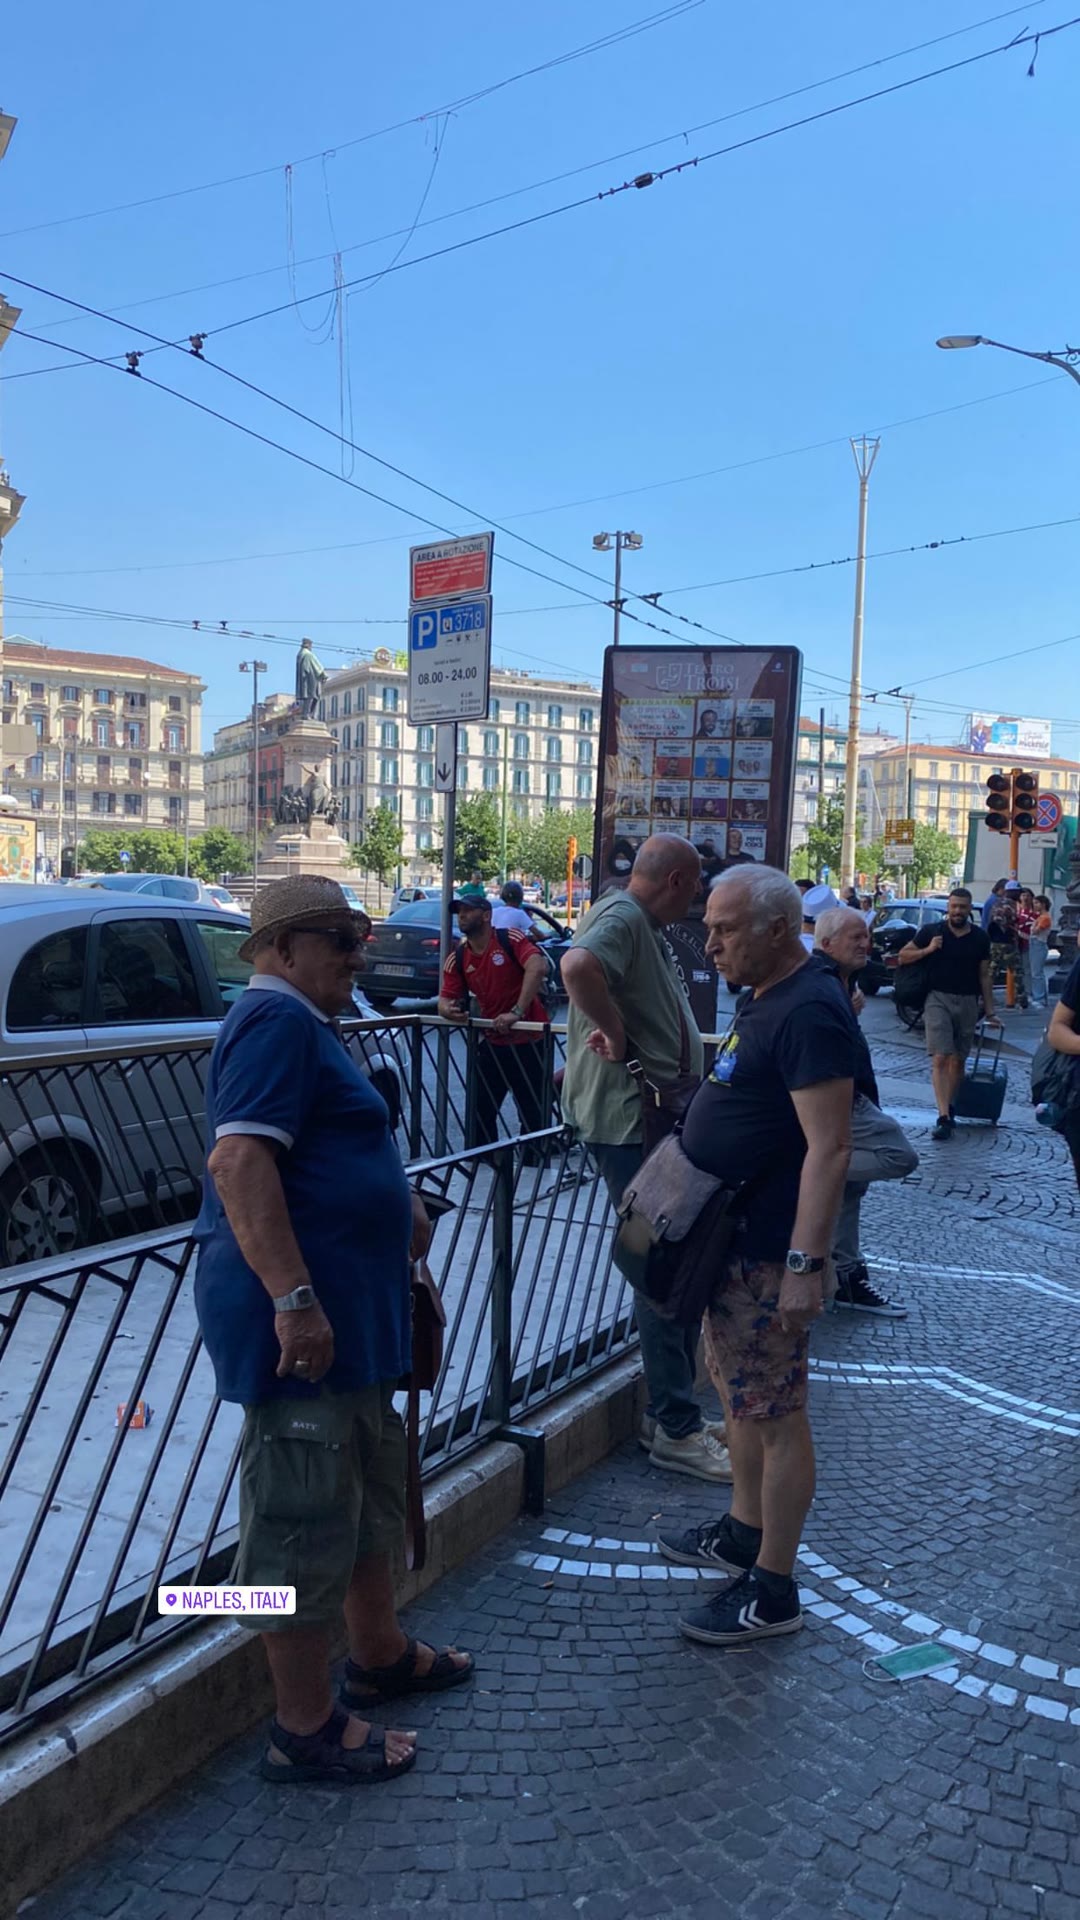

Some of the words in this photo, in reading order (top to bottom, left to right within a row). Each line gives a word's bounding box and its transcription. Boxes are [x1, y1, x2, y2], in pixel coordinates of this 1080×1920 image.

[417, 552, 436, 562] AREA
[437, 551, 442, 559] A
[443, 541, 485, 557] ROTAZIONE
[455, 610, 482, 632] 3718
[418, 616, 434, 646] P
[418, 671, 443, 685] 08.00
[451, 667, 477, 682] 24.00
[685, 663, 735, 674] TEATRO
[684, 674, 740, 690] TROISI
